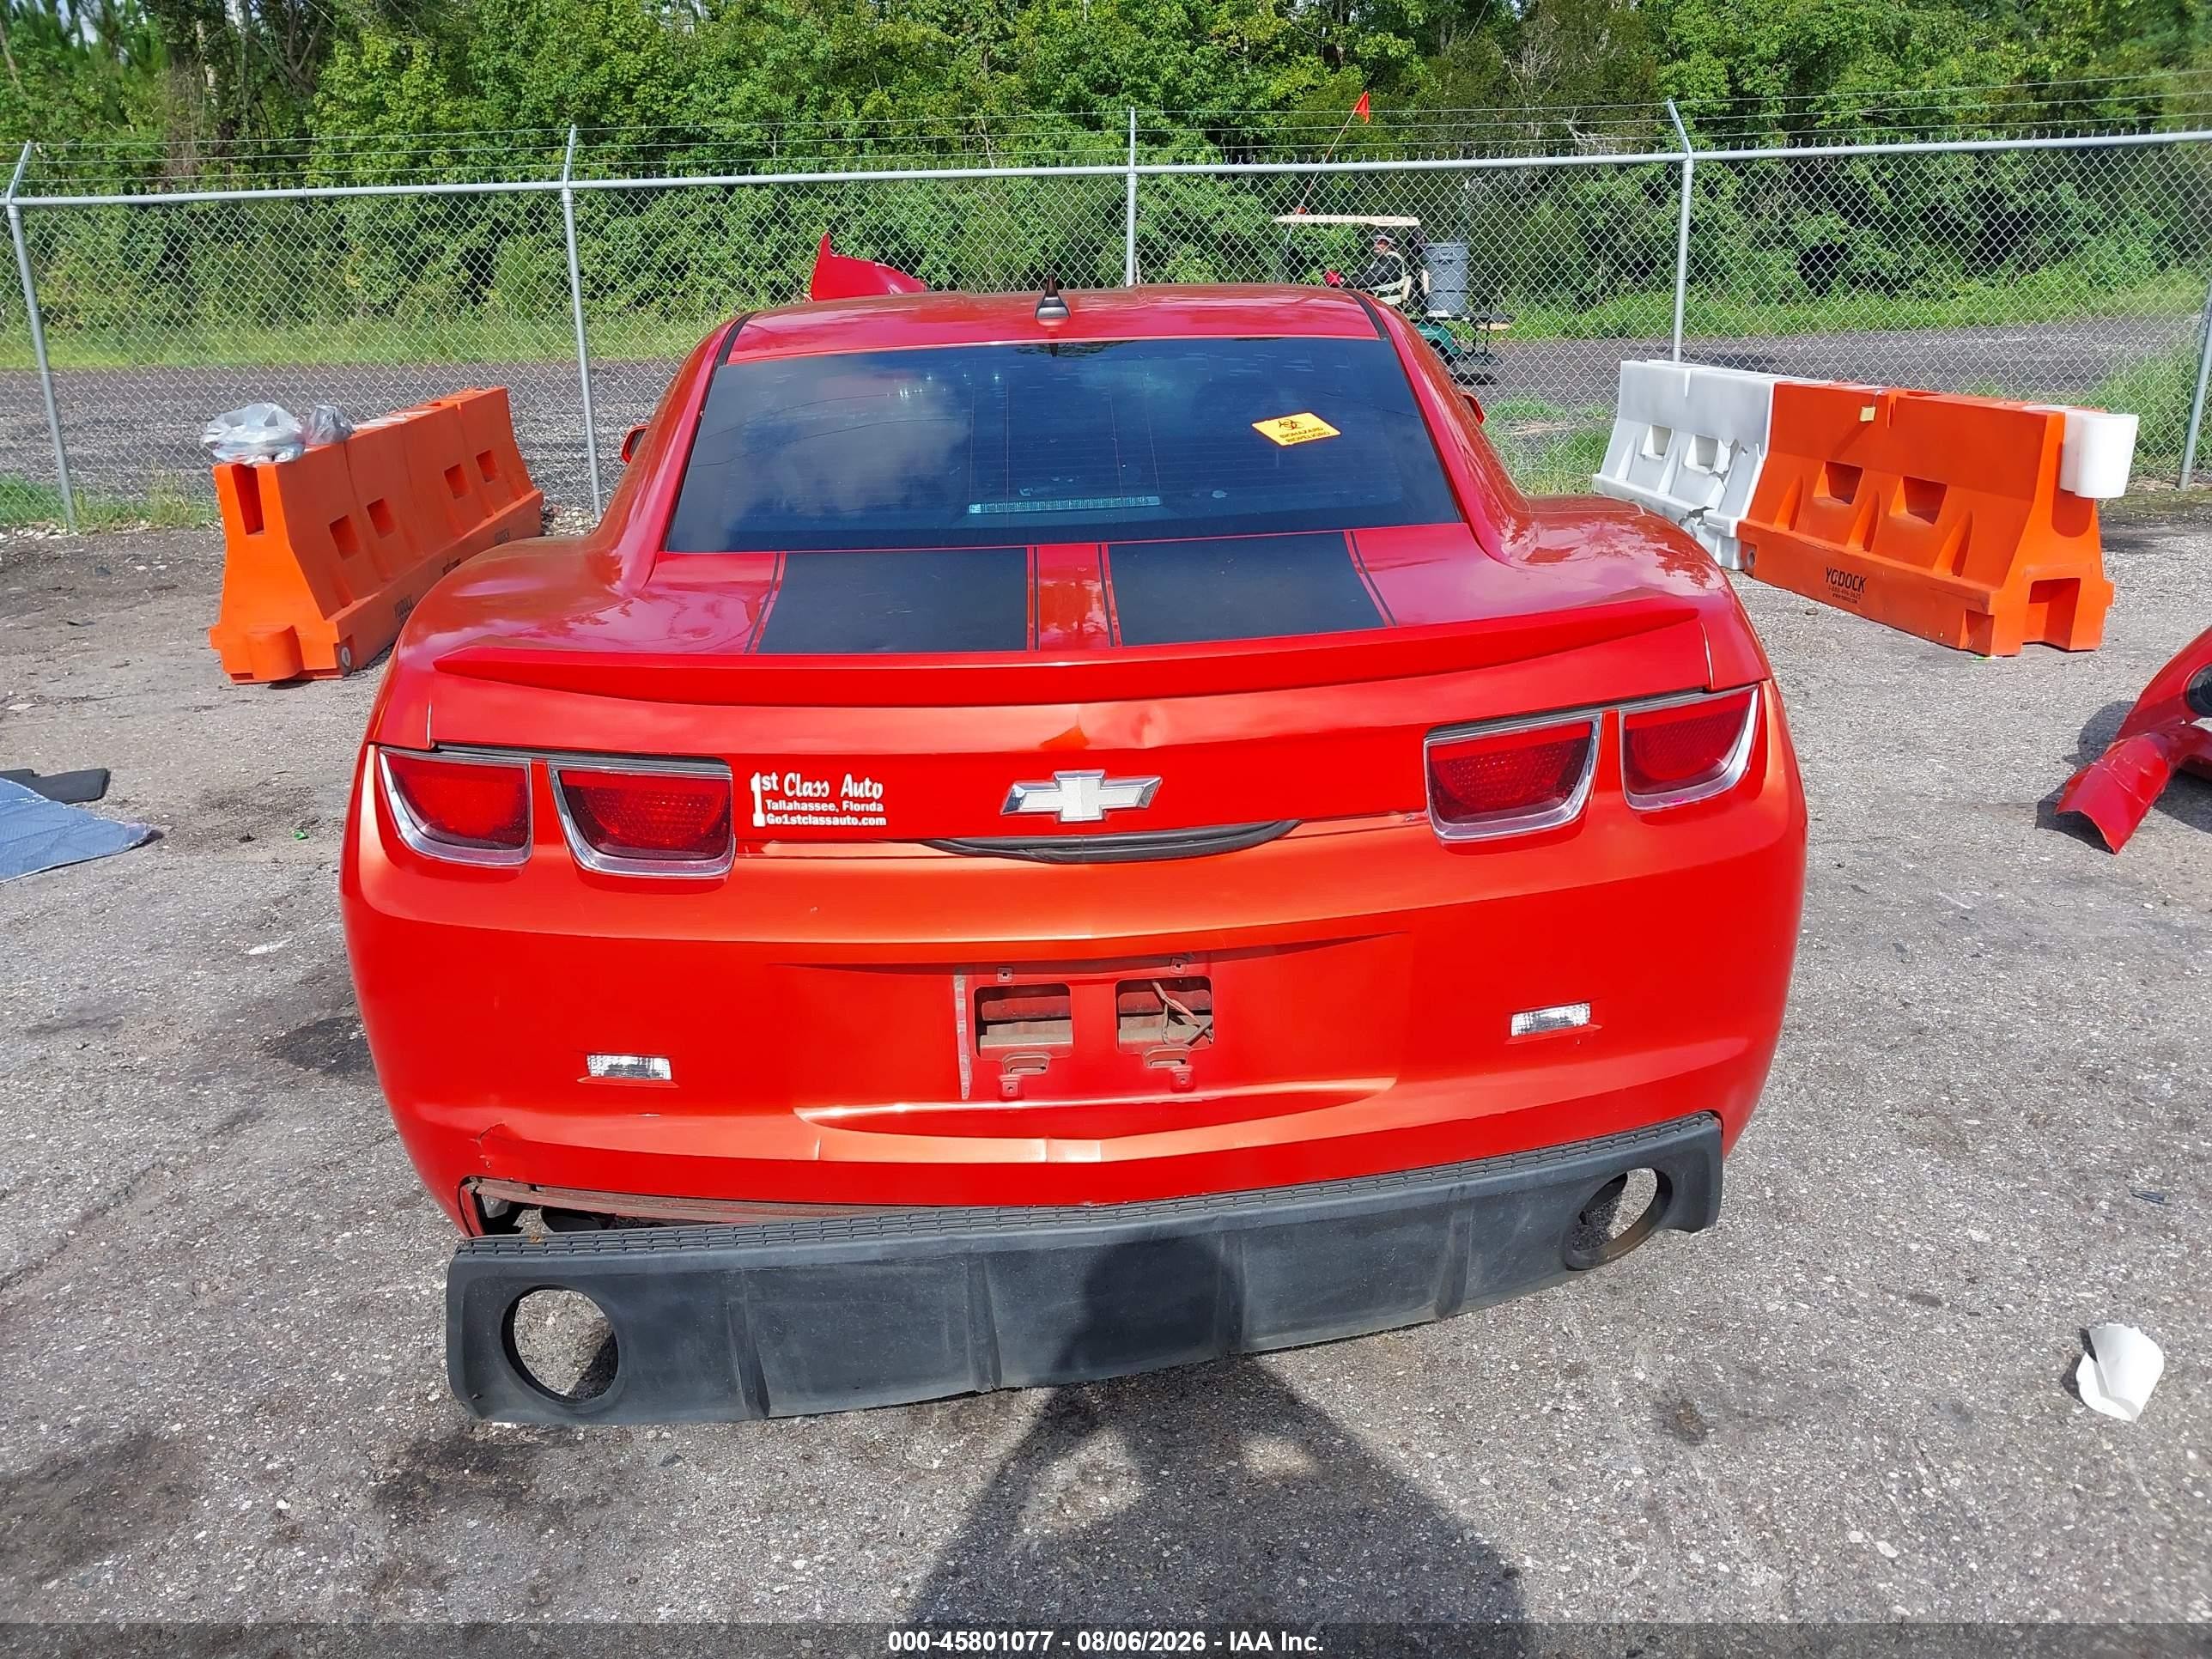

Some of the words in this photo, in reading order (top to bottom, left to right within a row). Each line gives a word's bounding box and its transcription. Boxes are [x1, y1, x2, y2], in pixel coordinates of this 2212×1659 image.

[750, 771, 780, 828] 1st
[783, 772, 830, 798] Class
[840, 773, 884, 799] Auto
[765, 799, 840, 813] Tallahassee,
[842, 799, 884, 812] Florida
[766, 813, 887, 826] Go1stclassauto.com
